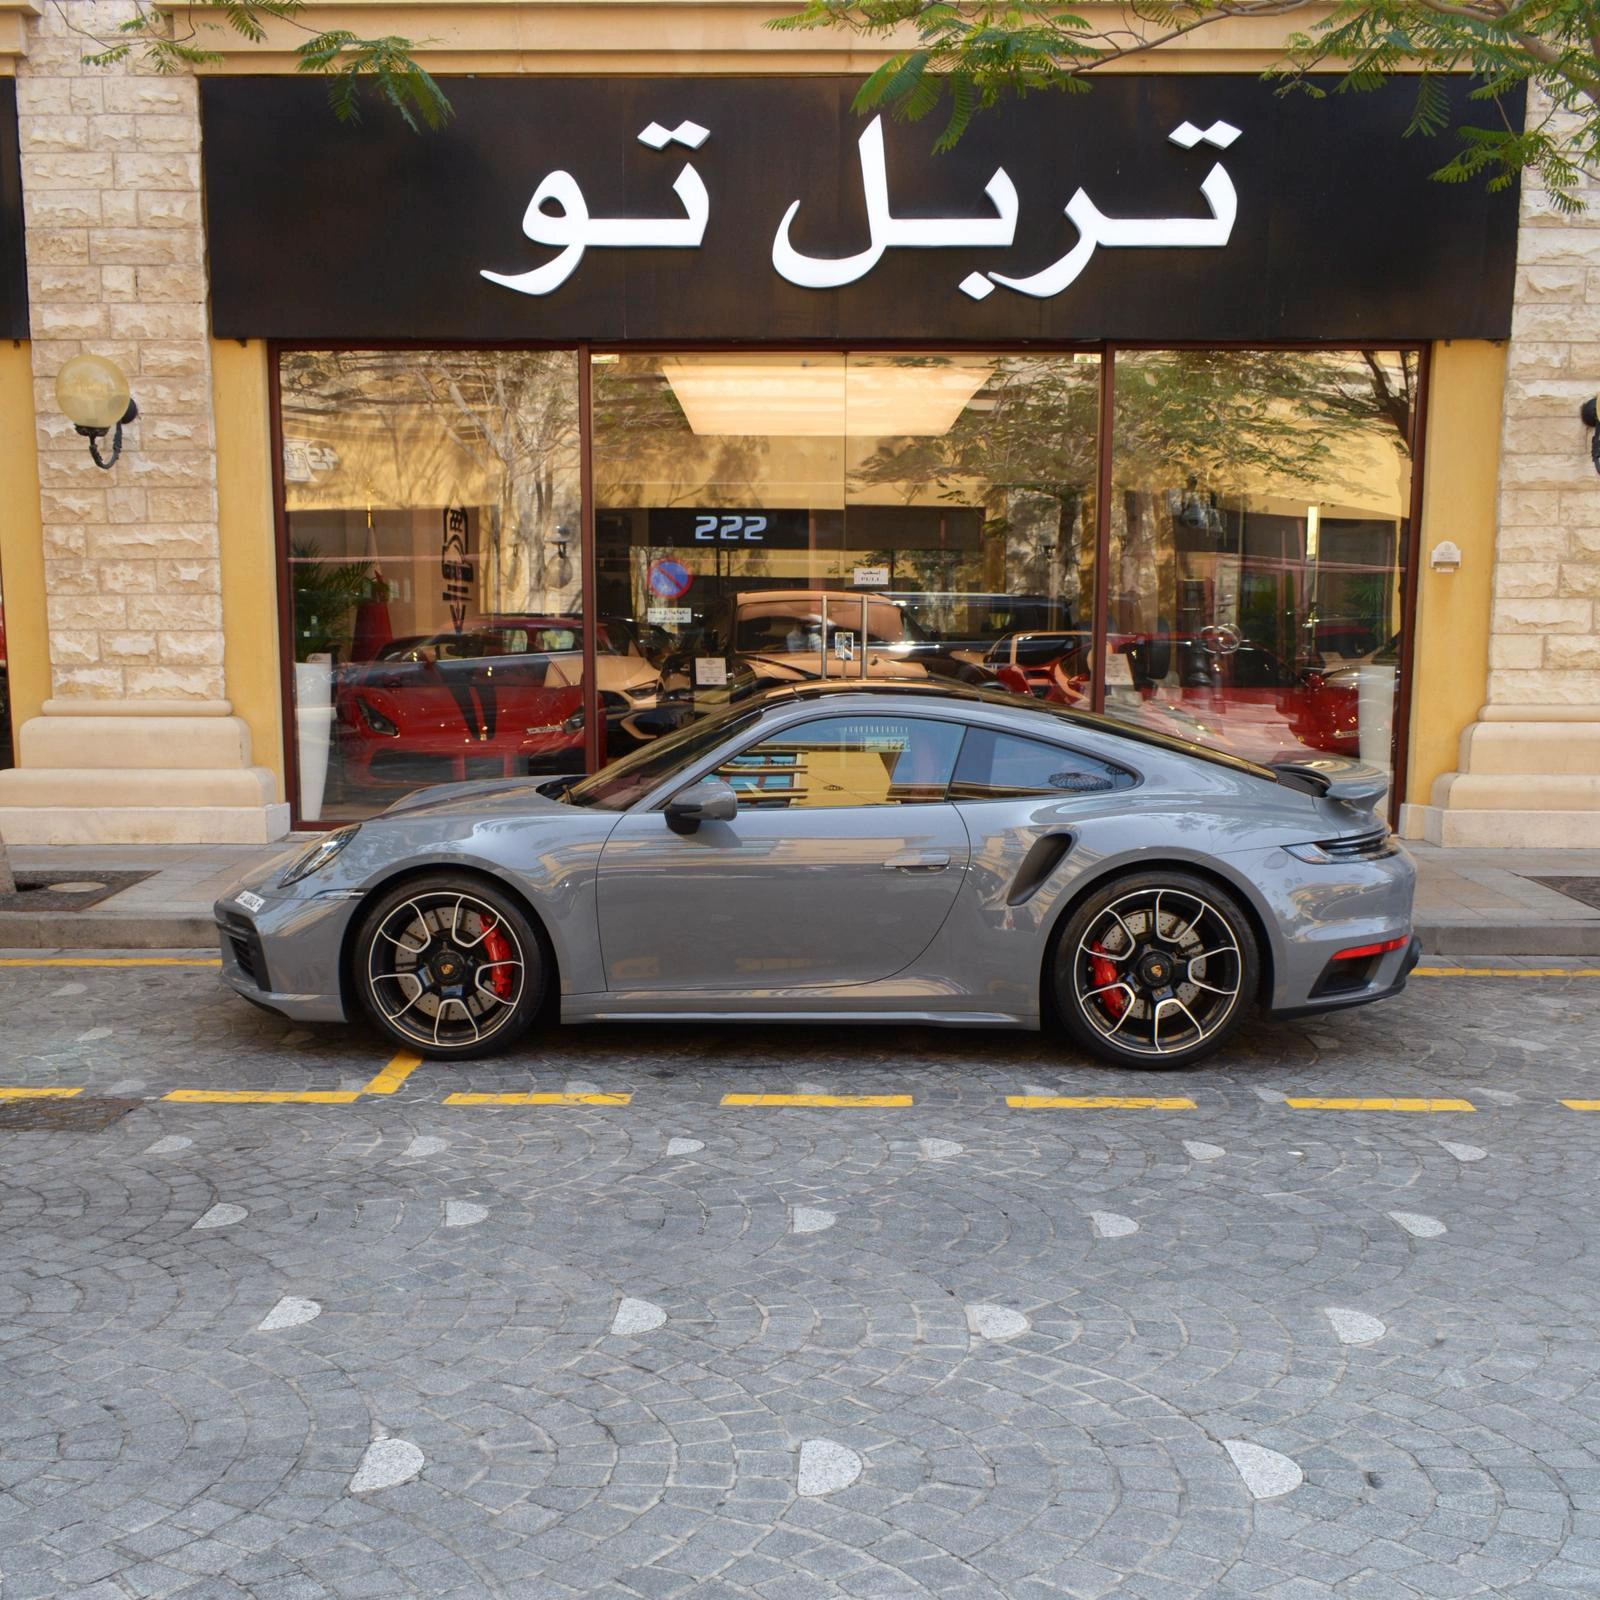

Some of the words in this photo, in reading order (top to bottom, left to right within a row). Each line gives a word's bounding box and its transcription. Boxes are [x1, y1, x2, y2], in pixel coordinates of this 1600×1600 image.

[479, 119, 711, 296] تو
[772, 114, 1243, 300] تربل
[695, 515, 767, 540] 222
